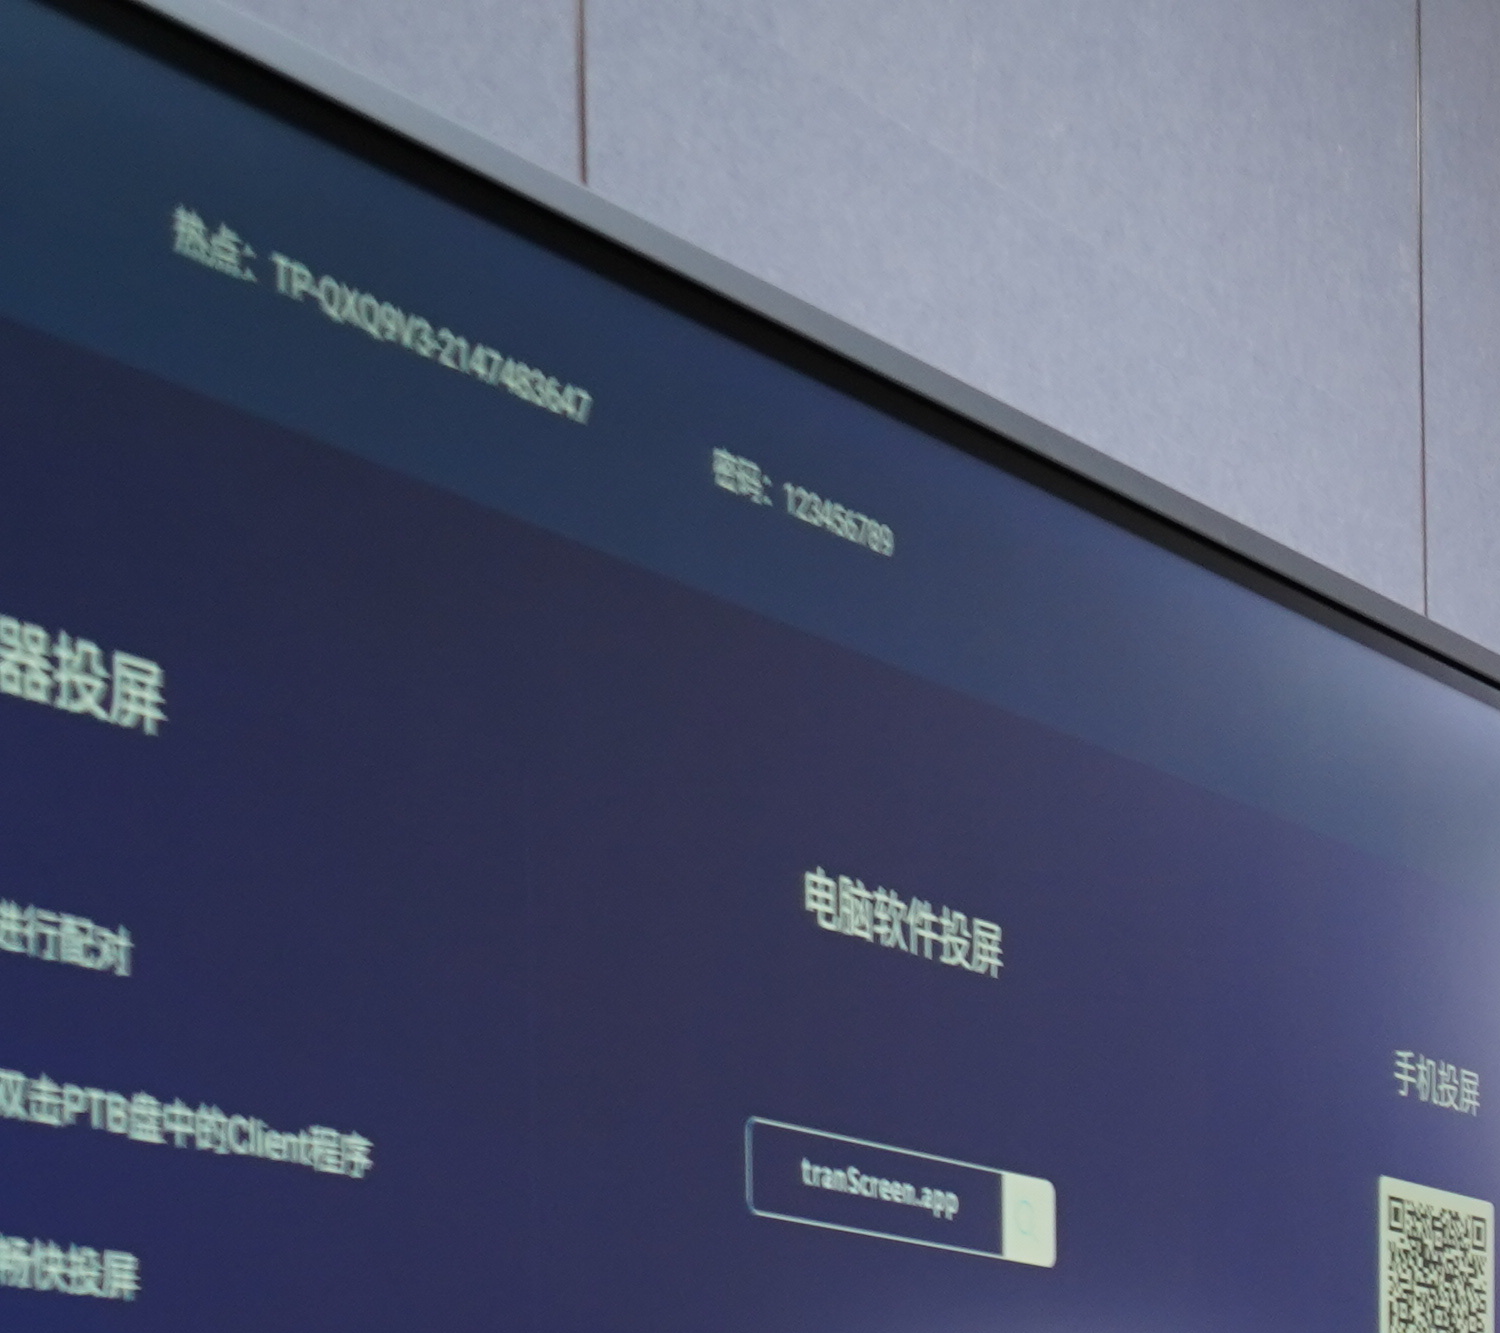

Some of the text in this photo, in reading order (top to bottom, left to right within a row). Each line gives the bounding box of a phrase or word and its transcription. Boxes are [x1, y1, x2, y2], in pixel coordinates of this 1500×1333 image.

[805, 866, 1003, 978] 电脑软件投屏
[1394, 1050, 1480, 1116] 手机投屏
[800, 1157, 960, 1220] tranScreen.app
